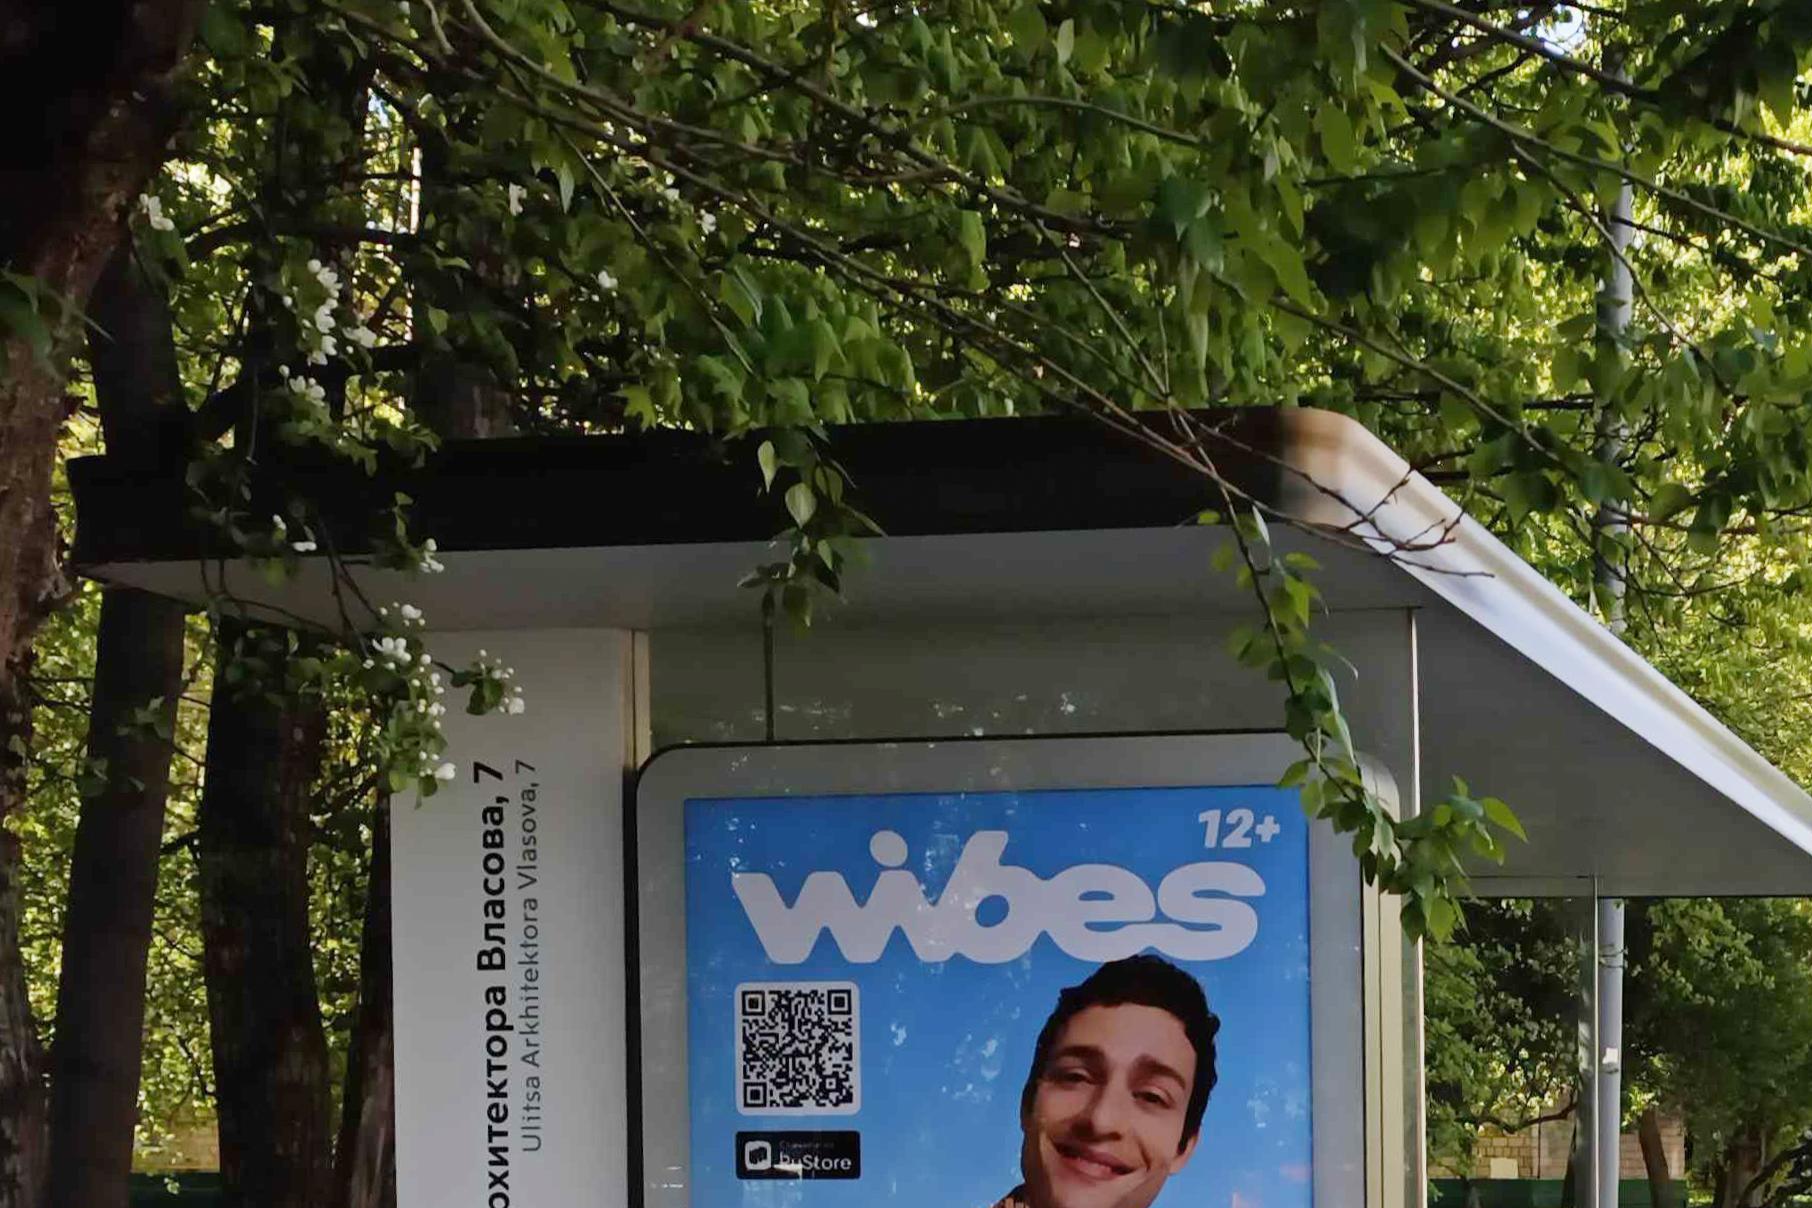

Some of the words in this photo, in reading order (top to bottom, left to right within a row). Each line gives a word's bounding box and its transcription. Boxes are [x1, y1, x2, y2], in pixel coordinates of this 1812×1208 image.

[474, 761, 503, 784] 7
[515, 759, 536, 774] 7
[517, 783, 540, 889] Vlasova,
[1198, 808, 1281, 849] 12+
[477, 796, 509, 970] Власова,
[731, 829, 1267, 965] wibes
[518, 898, 541, 1068] Arkhitektora
[521, 1075, 542, 1152] Ulitsa
